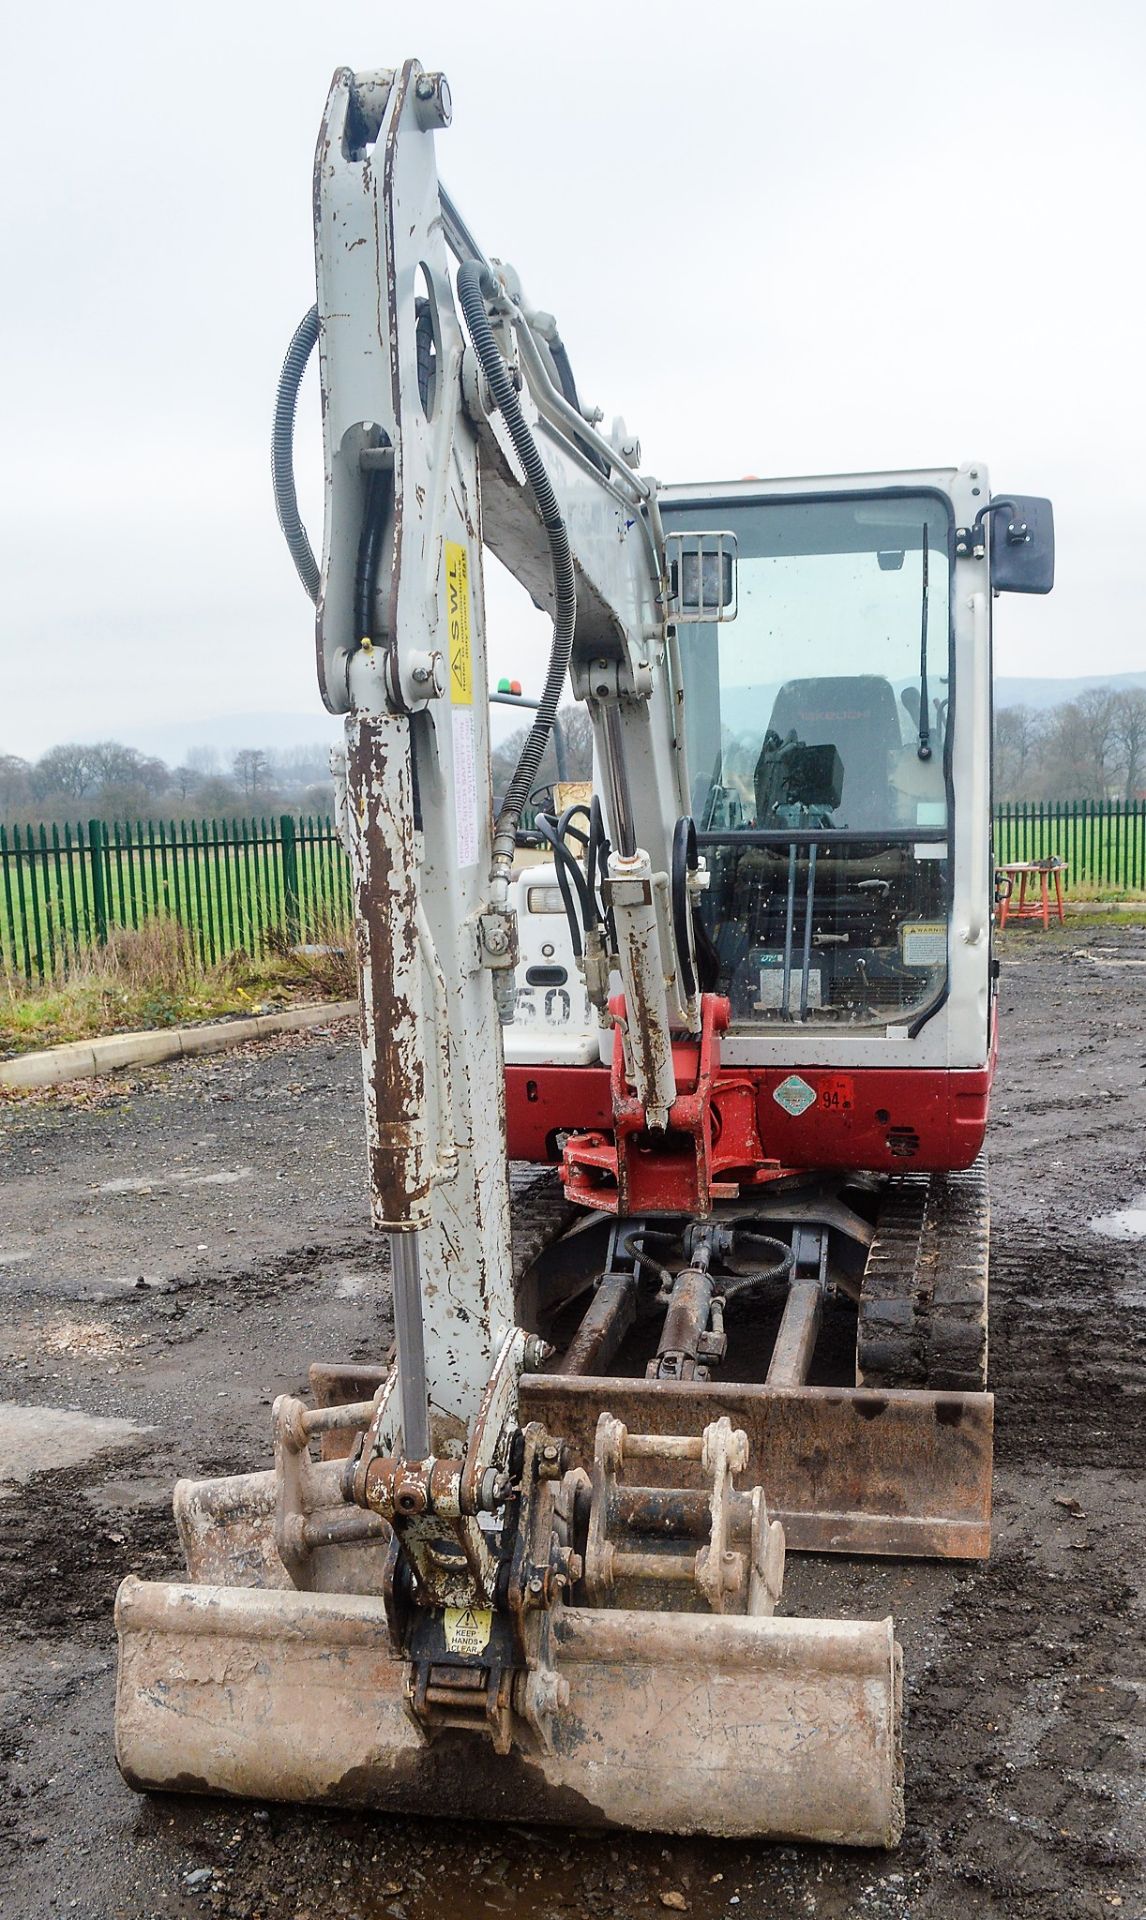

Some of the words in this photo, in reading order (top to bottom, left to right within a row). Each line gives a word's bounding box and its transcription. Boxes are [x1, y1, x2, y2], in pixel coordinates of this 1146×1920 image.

[455, 1629, 477, 1637] KEEP
[451, 1637, 479, 1646] HANDS
[450, 1644, 478, 1653] CLEAR
